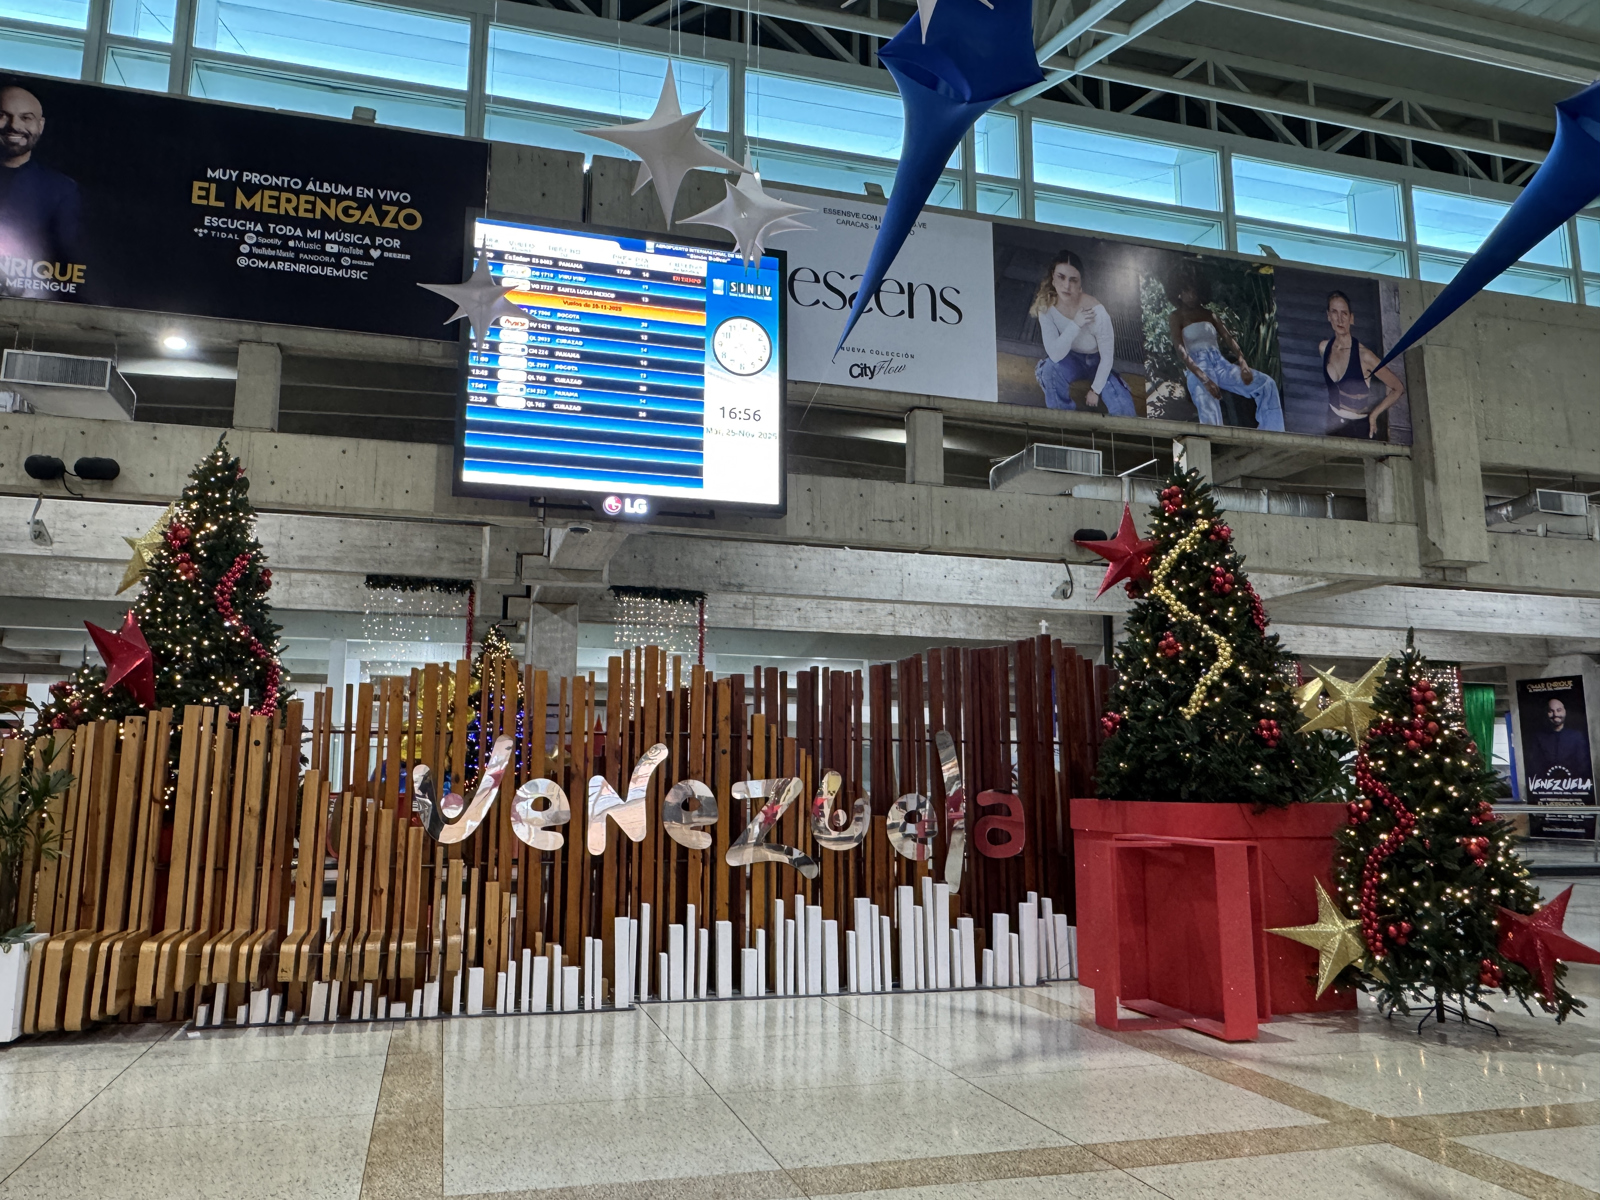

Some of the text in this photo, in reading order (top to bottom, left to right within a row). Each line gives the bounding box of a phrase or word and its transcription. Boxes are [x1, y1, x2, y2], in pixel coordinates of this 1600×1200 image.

[207, 168, 411, 204] MUY PRONTO ÁLBUM EN VIVO
[191, 180, 422, 230] EL MERENGAZO
[836, 218, 870, 230] CARACAS
[204, 216, 400, 248] ESCUCHA TODA MI MÚSICA POR
[211, 230, 240, 240] TIDAL
[258, 236, 282, 246] Spotify
[295, 240, 322, 250] Music
[338, 245, 364, 256] YouTube
[299, 253, 336, 264] PANDORA
[236, 256, 368, 280] @OMARENRIQUEMUSIC
[6, 278, 76, 294] MERENGUE
[730, 282, 772, 296] SINIV
[840, 346, 915, 359] NUEVA COLECCIÓN
[719, 406, 762, 422] 16:56
[624, 498, 647, 514] LG
[1528, 774, 1593, 792] VENEZUELA
